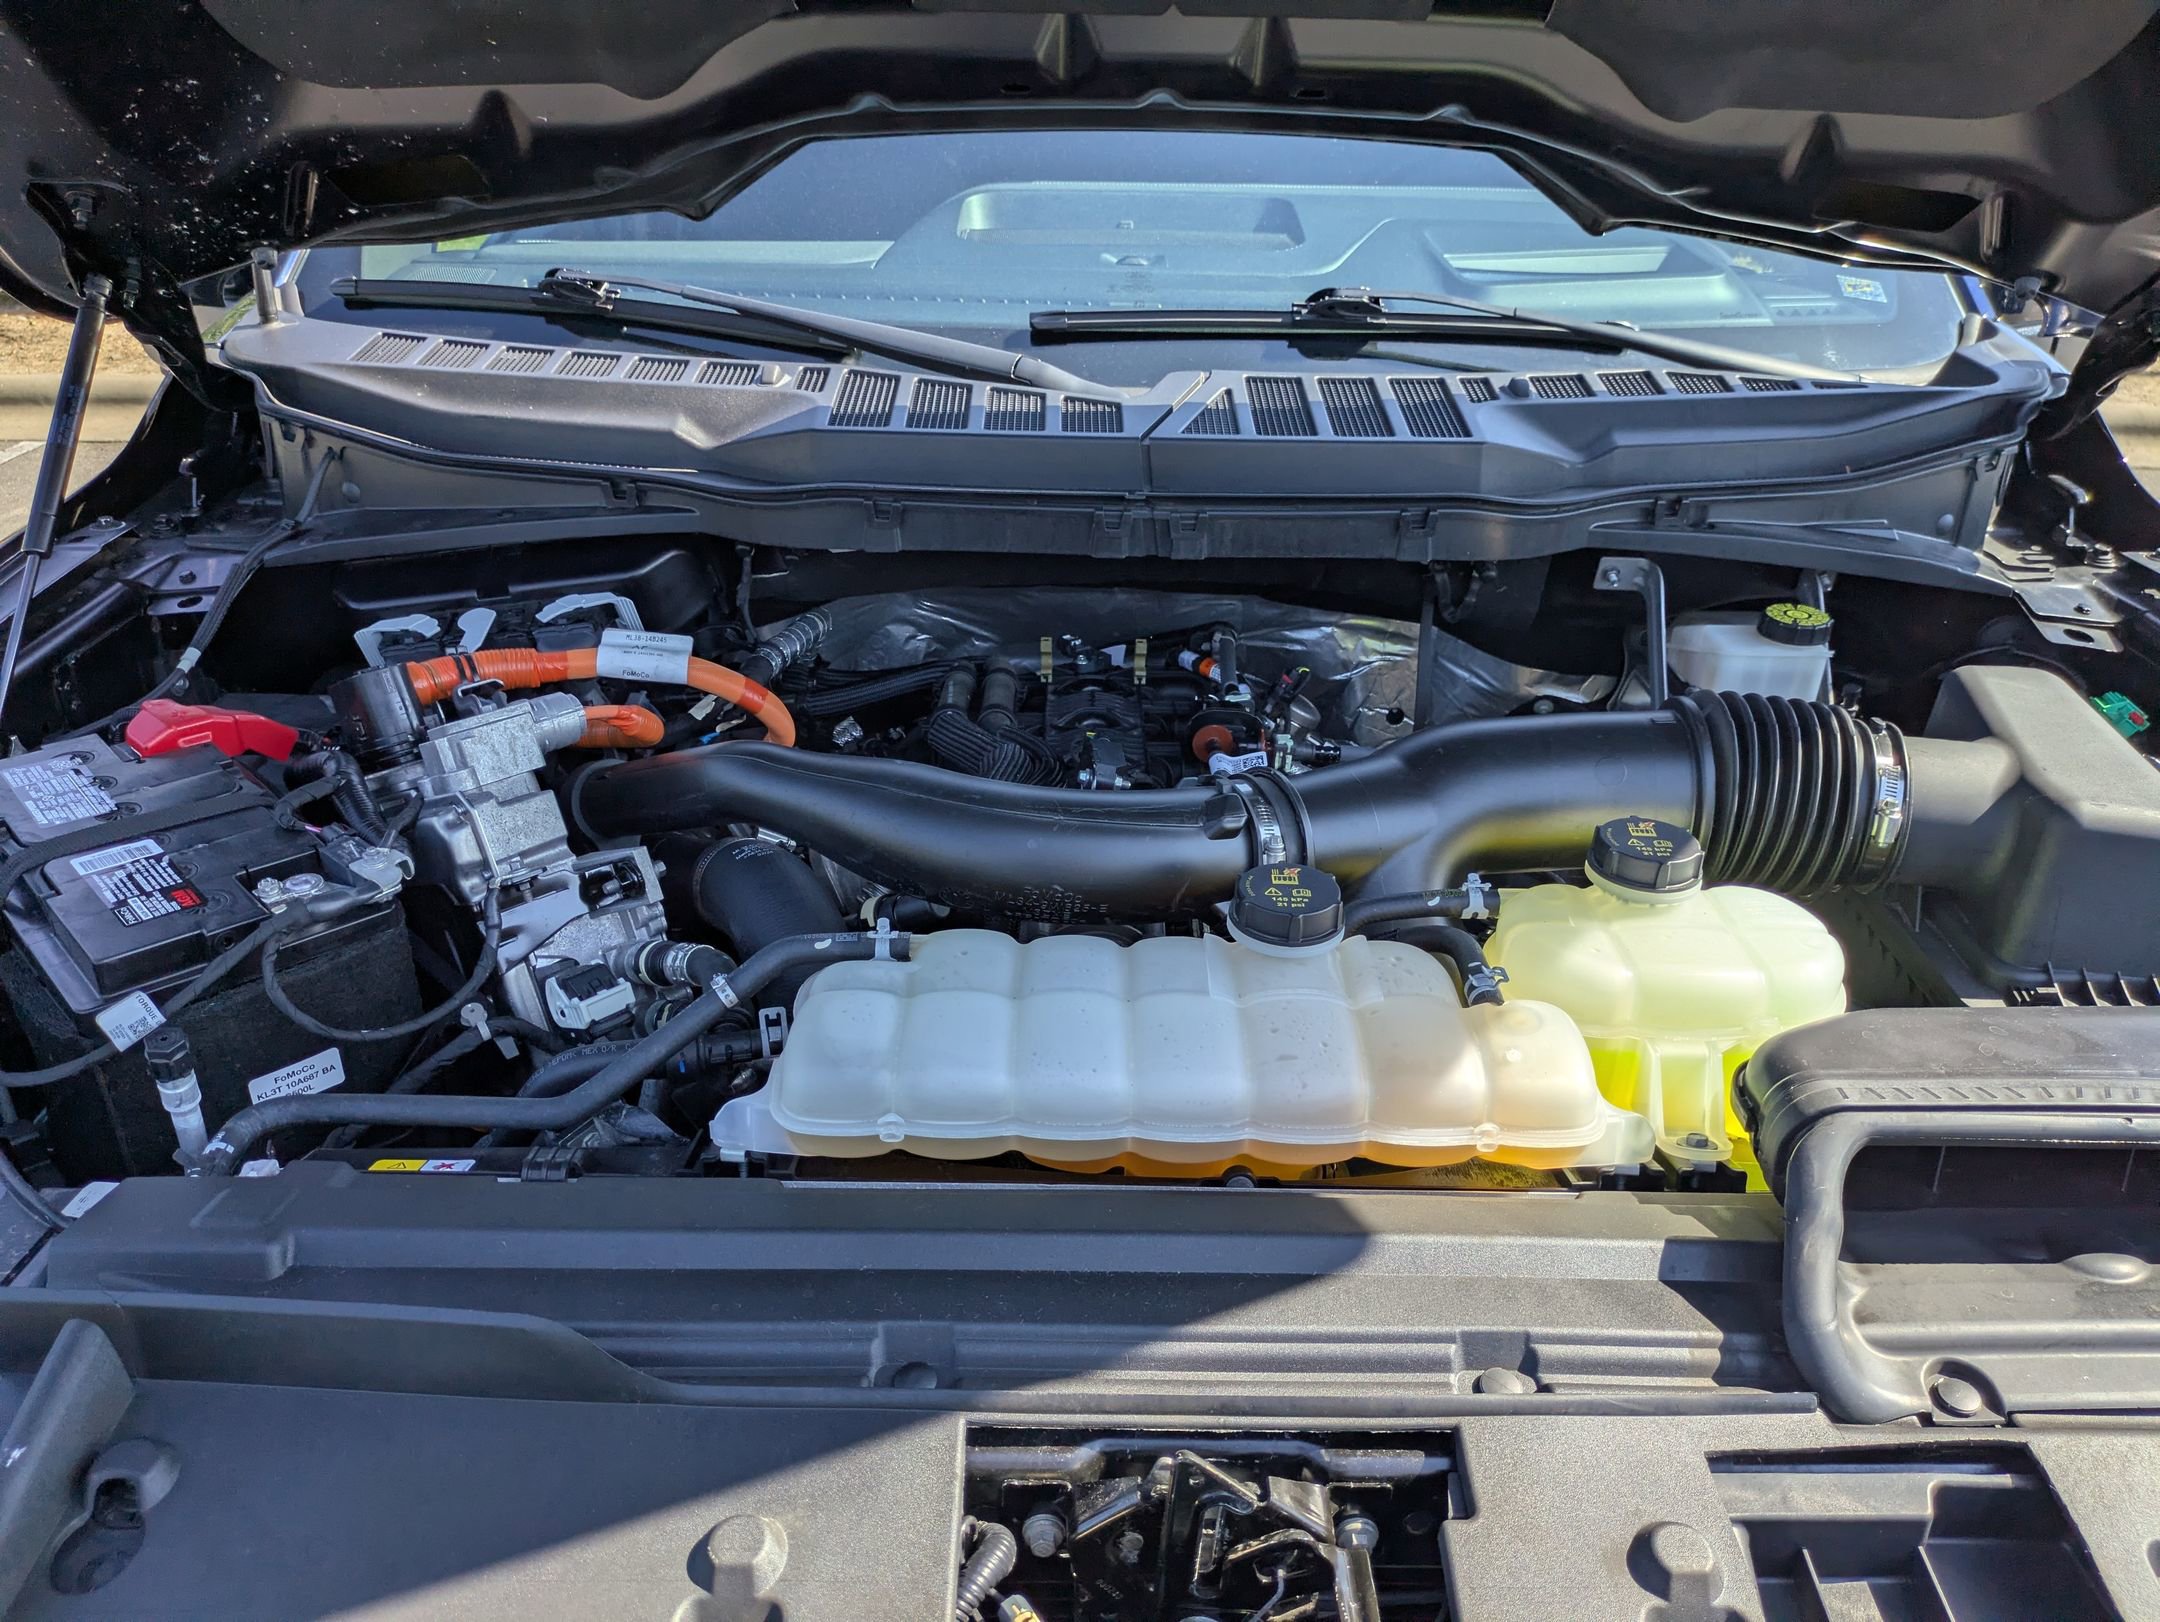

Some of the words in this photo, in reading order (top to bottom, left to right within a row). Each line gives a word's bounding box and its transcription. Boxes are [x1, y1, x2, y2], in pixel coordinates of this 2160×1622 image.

[622, 669, 650, 679] FoMoCo
[136, 994, 158, 1021] TORQUE
[256, 1086, 283, 1101] KL3T
[286, 1071, 319, 1090] 10A687
[322, 1064, 336, 1075] BA
[274, 1064, 316, 1084] FoMoCo
